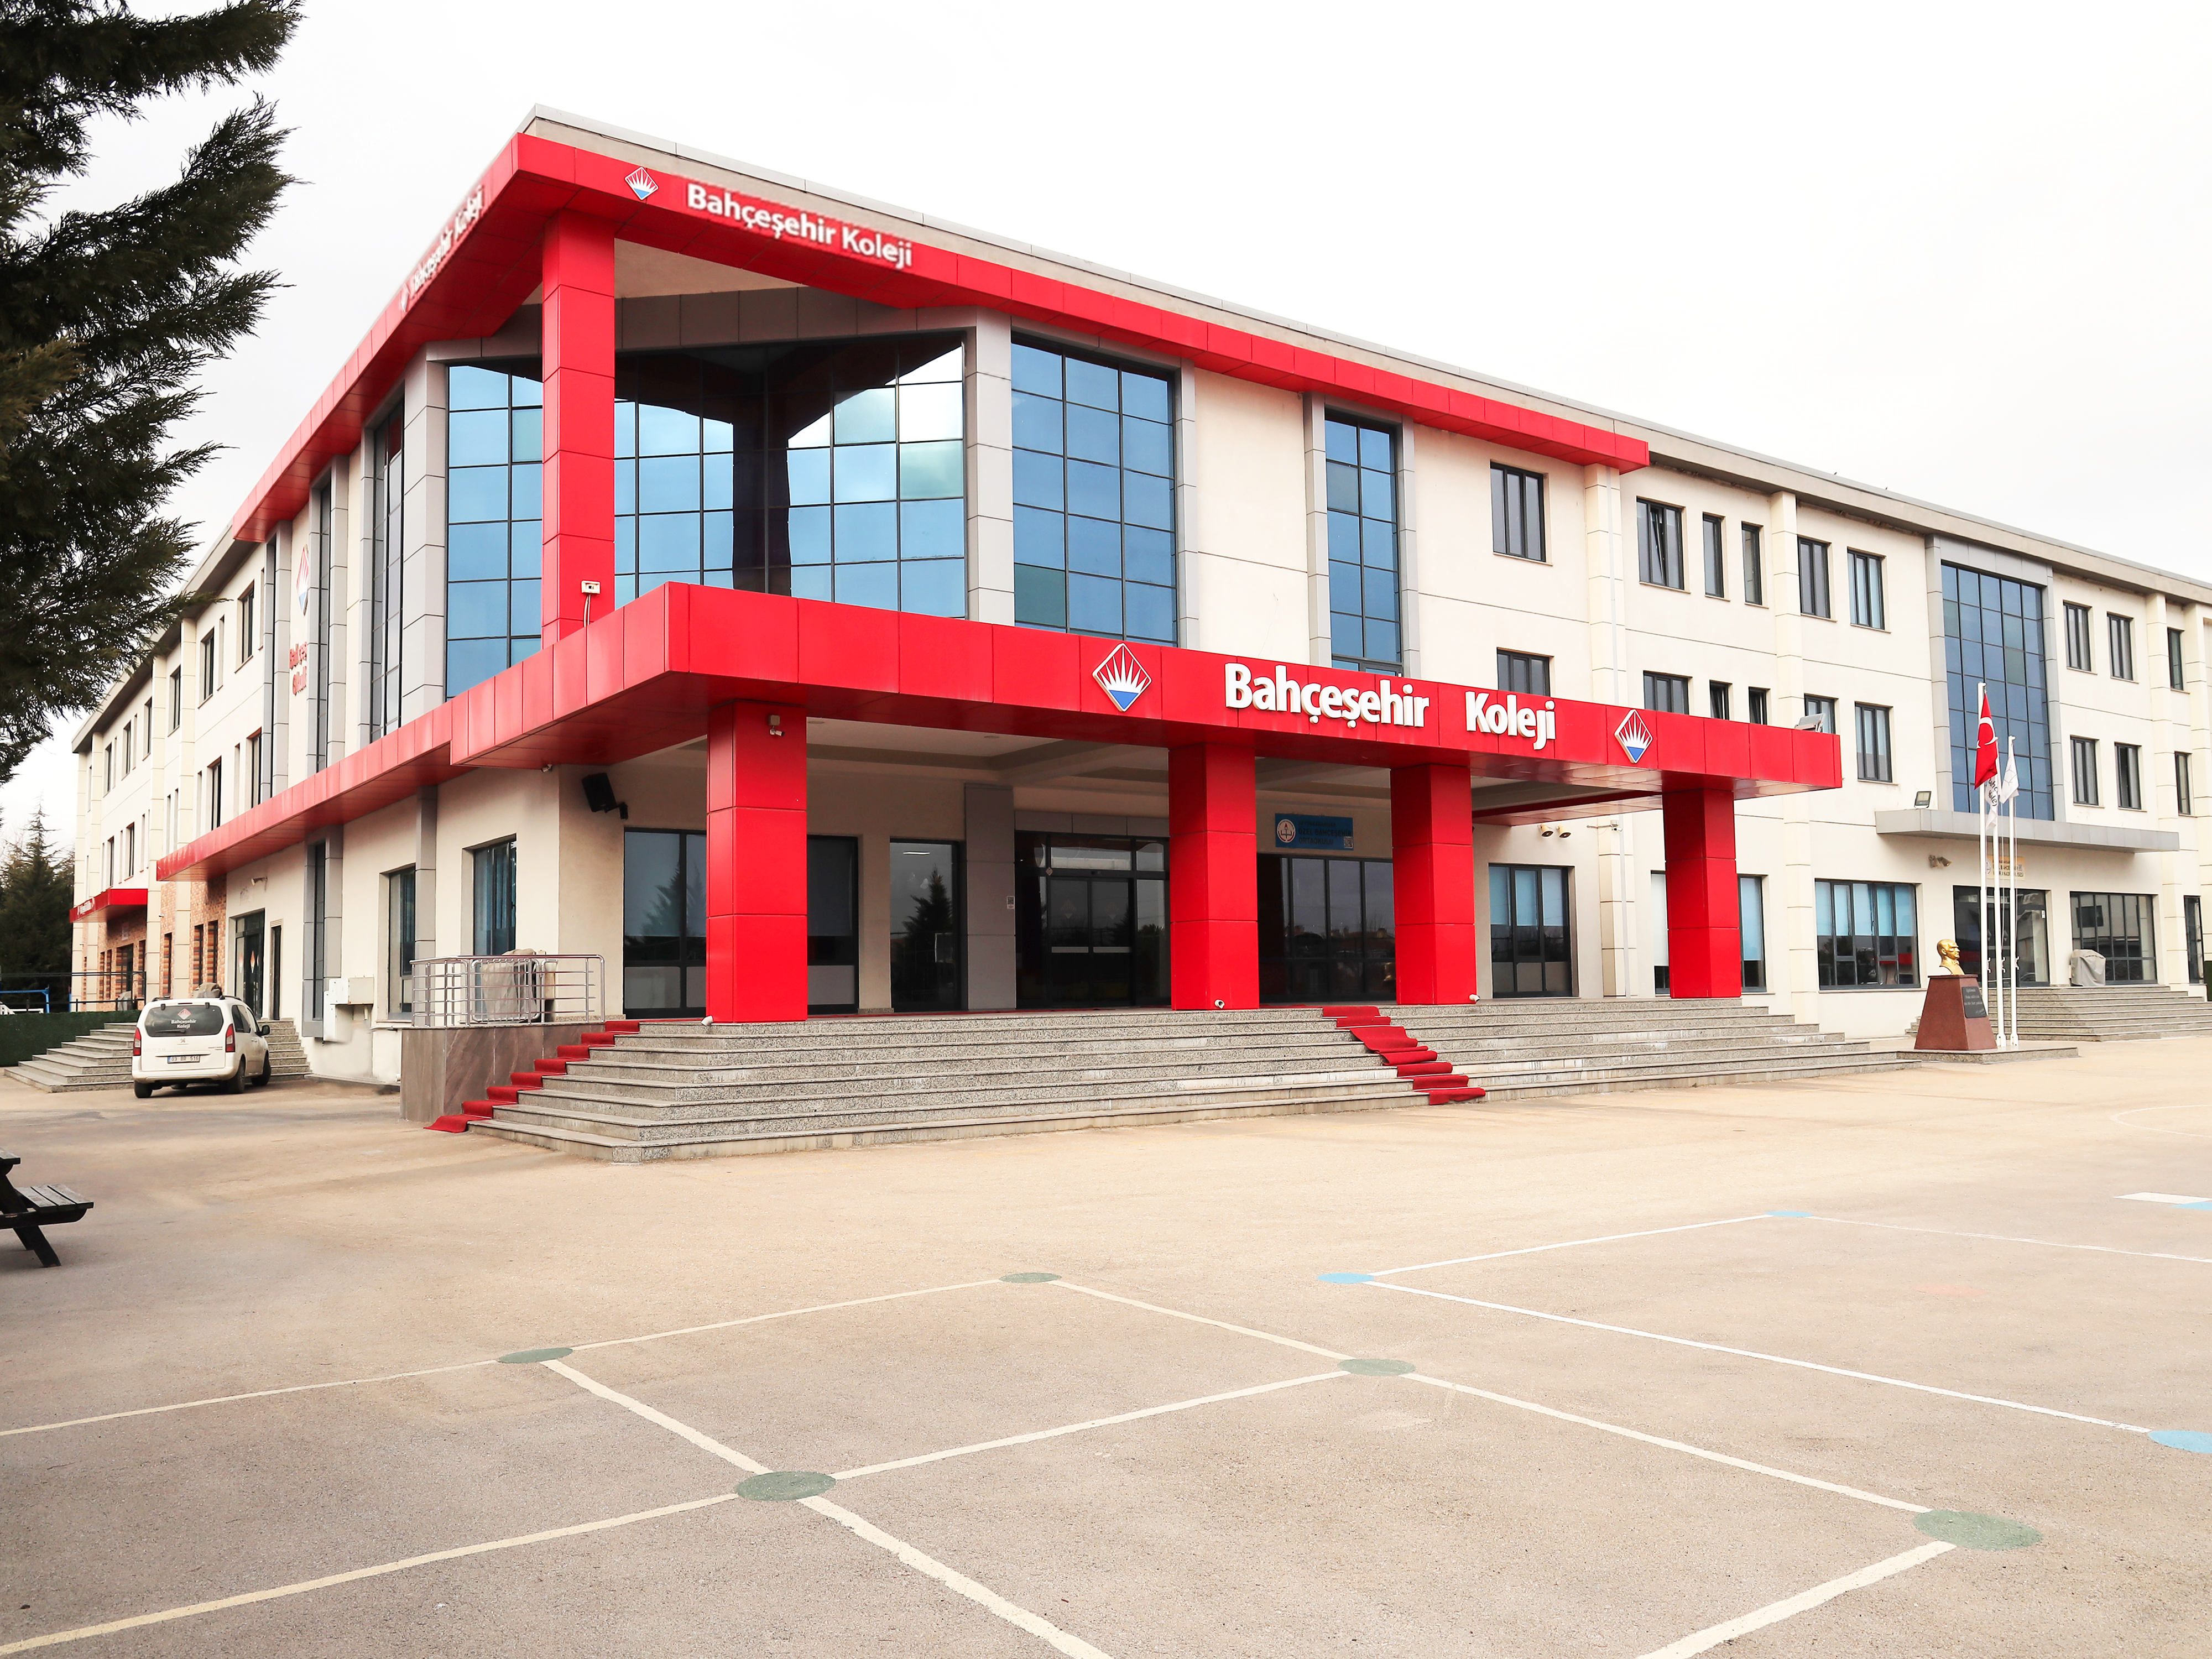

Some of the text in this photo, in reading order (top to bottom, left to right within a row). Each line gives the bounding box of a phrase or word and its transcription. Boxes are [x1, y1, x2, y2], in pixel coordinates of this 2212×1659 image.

[687, 183, 912, 269] Bahçeşehir Koleji
[1225, 662, 1556, 750] Bahçeşehir Koleji
[1298, 827, 1352, 837] ÖZEL BAHÇEŞEHİR
